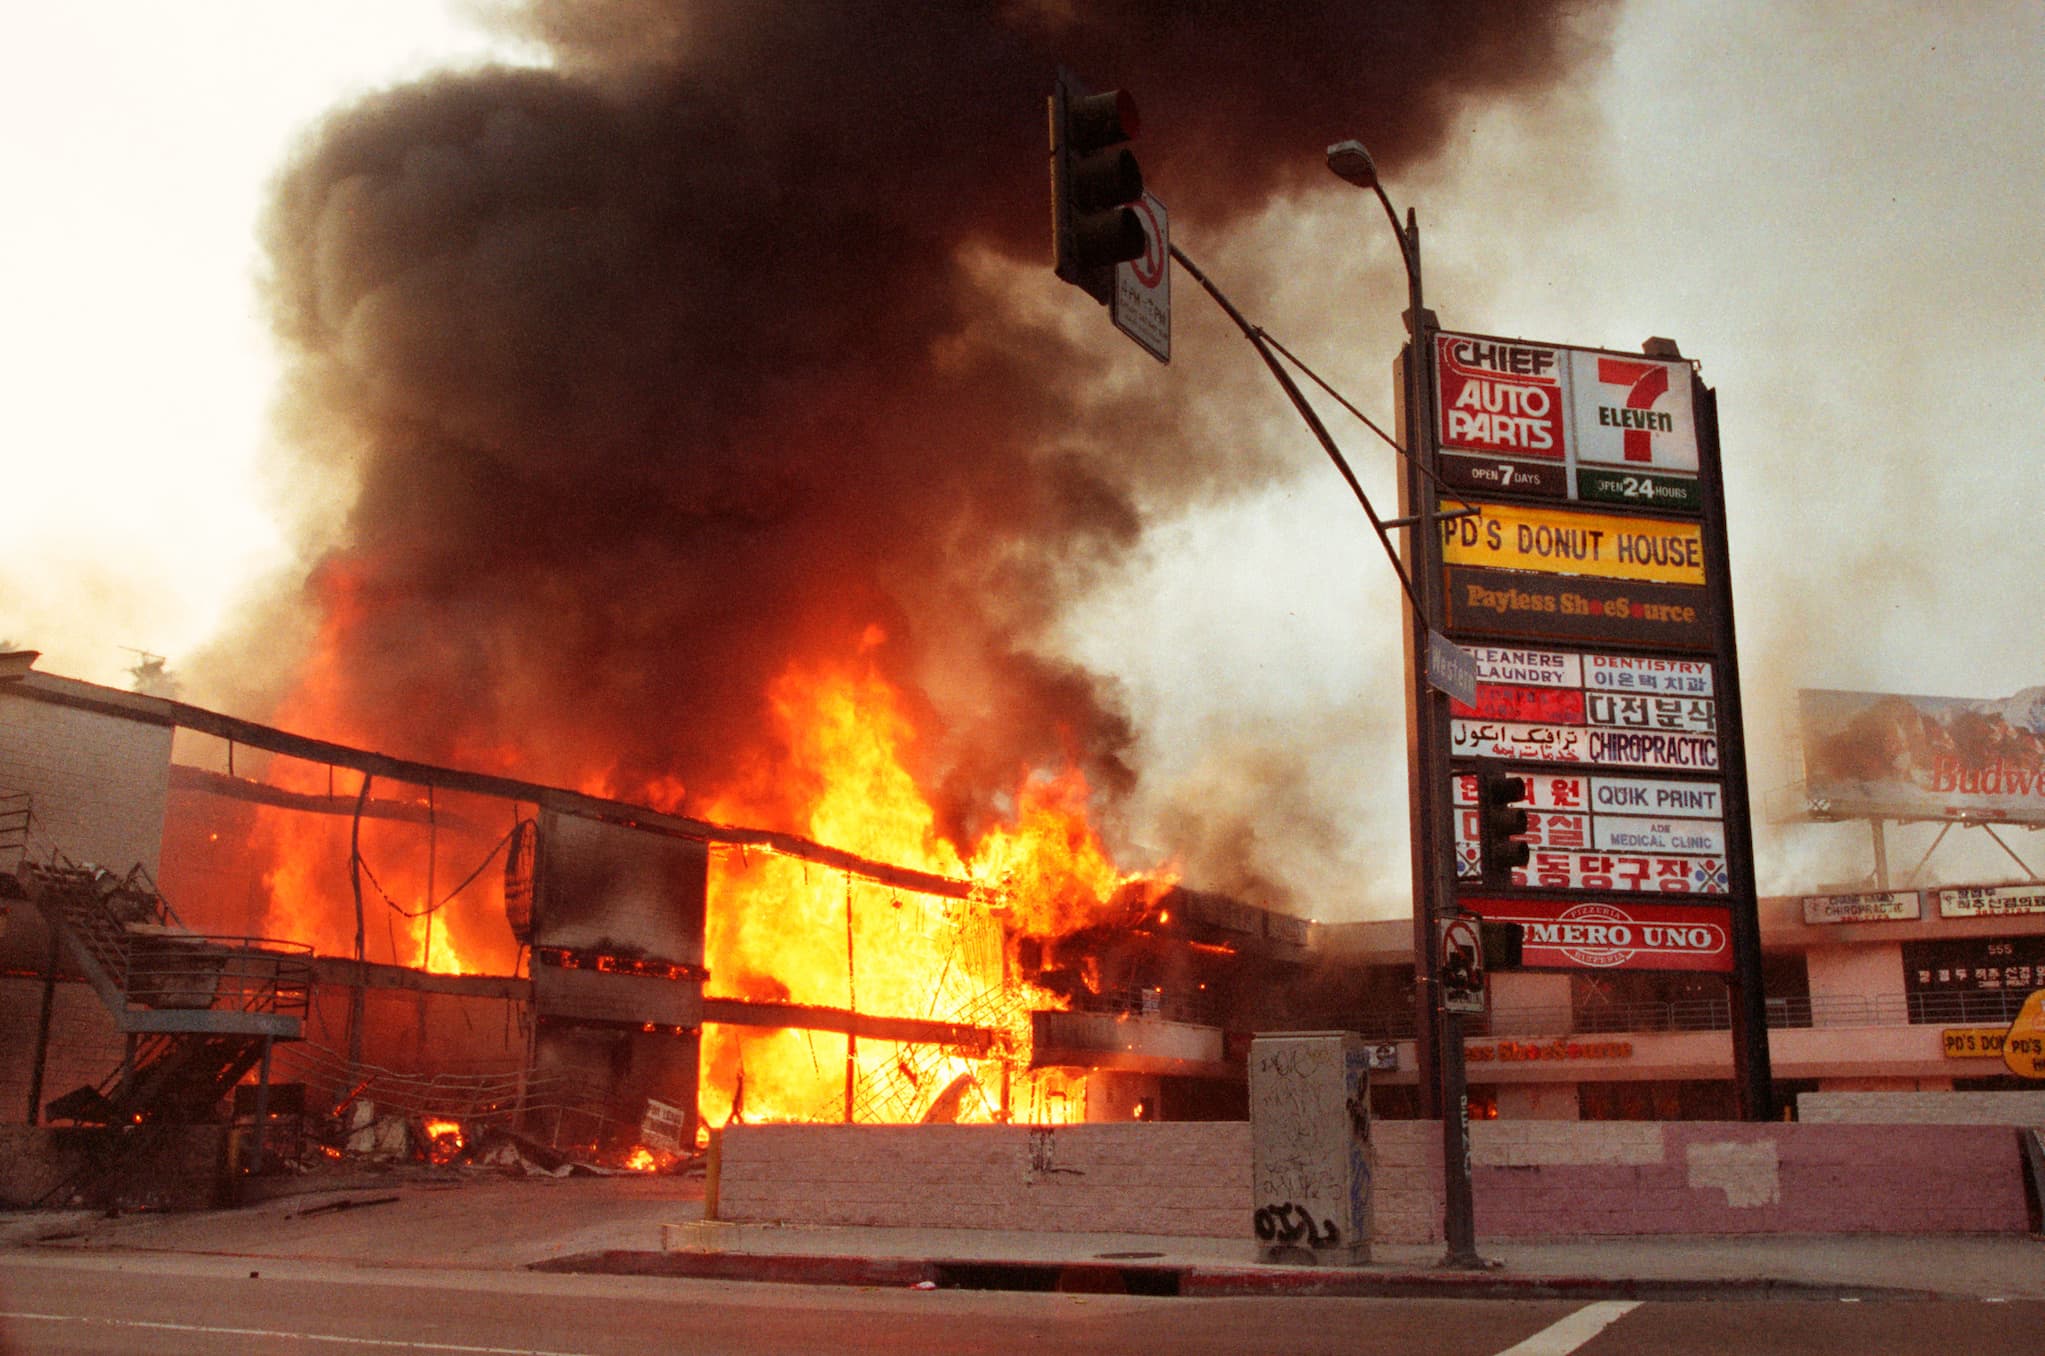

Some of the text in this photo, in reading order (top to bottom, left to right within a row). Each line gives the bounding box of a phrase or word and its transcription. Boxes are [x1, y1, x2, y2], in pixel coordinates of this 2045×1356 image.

[1454, 340, 1554, 375] CHIEF
[1455, 379, 1550, 418] AUTO
[1598, 357, 1669, 463] 7
[1448, 409, 1553, 450] PARTS
[1472, 465, 1541, 486] OPEN 7 DAYS
[1623, 477, 1655, 499] 24
[1655, 486, 1687, 499] HOURS
[1444, 516, 1701, 568] PD'S DONUT HOUSE
[1466, 583, 1557, 614] Payless
[1462, 648, 1565, 668] LEANERS
[1593, 655, 1707, 675] DENTISTRY
[1476, 665, 1565, 683] LAUNDRY
[1589, 731, 1717, 767] CHIROPRACTIC
[1656, 789, 1717, 810] PRINT
[1610, 833, 1712, 849] MEDICAL CLINIC
[1643, 927, 1712, 948] UNO
